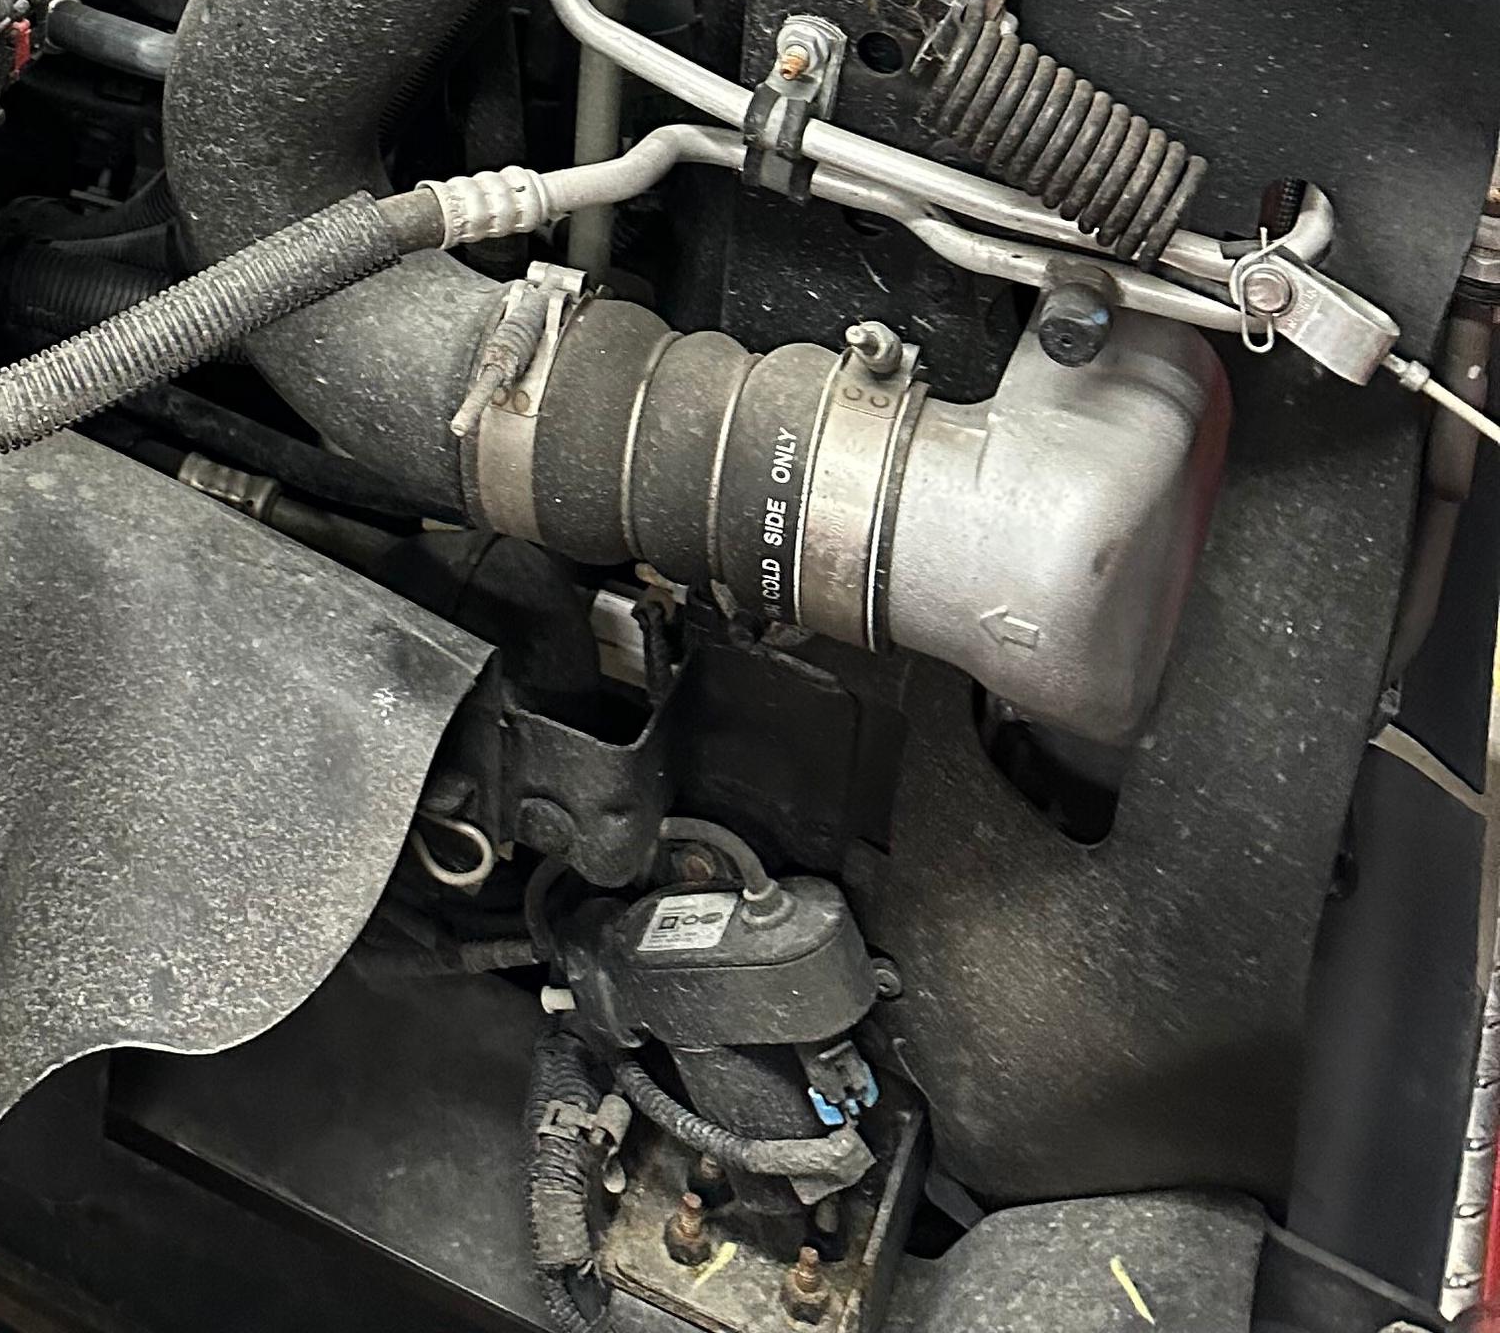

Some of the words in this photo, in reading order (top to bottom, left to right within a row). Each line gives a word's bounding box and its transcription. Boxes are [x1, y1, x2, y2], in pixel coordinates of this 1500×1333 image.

[771, 426, 799, 485] ONLY
[762, 497, 788, 548] SIDE
[761, 558, 782, 601] COLD
